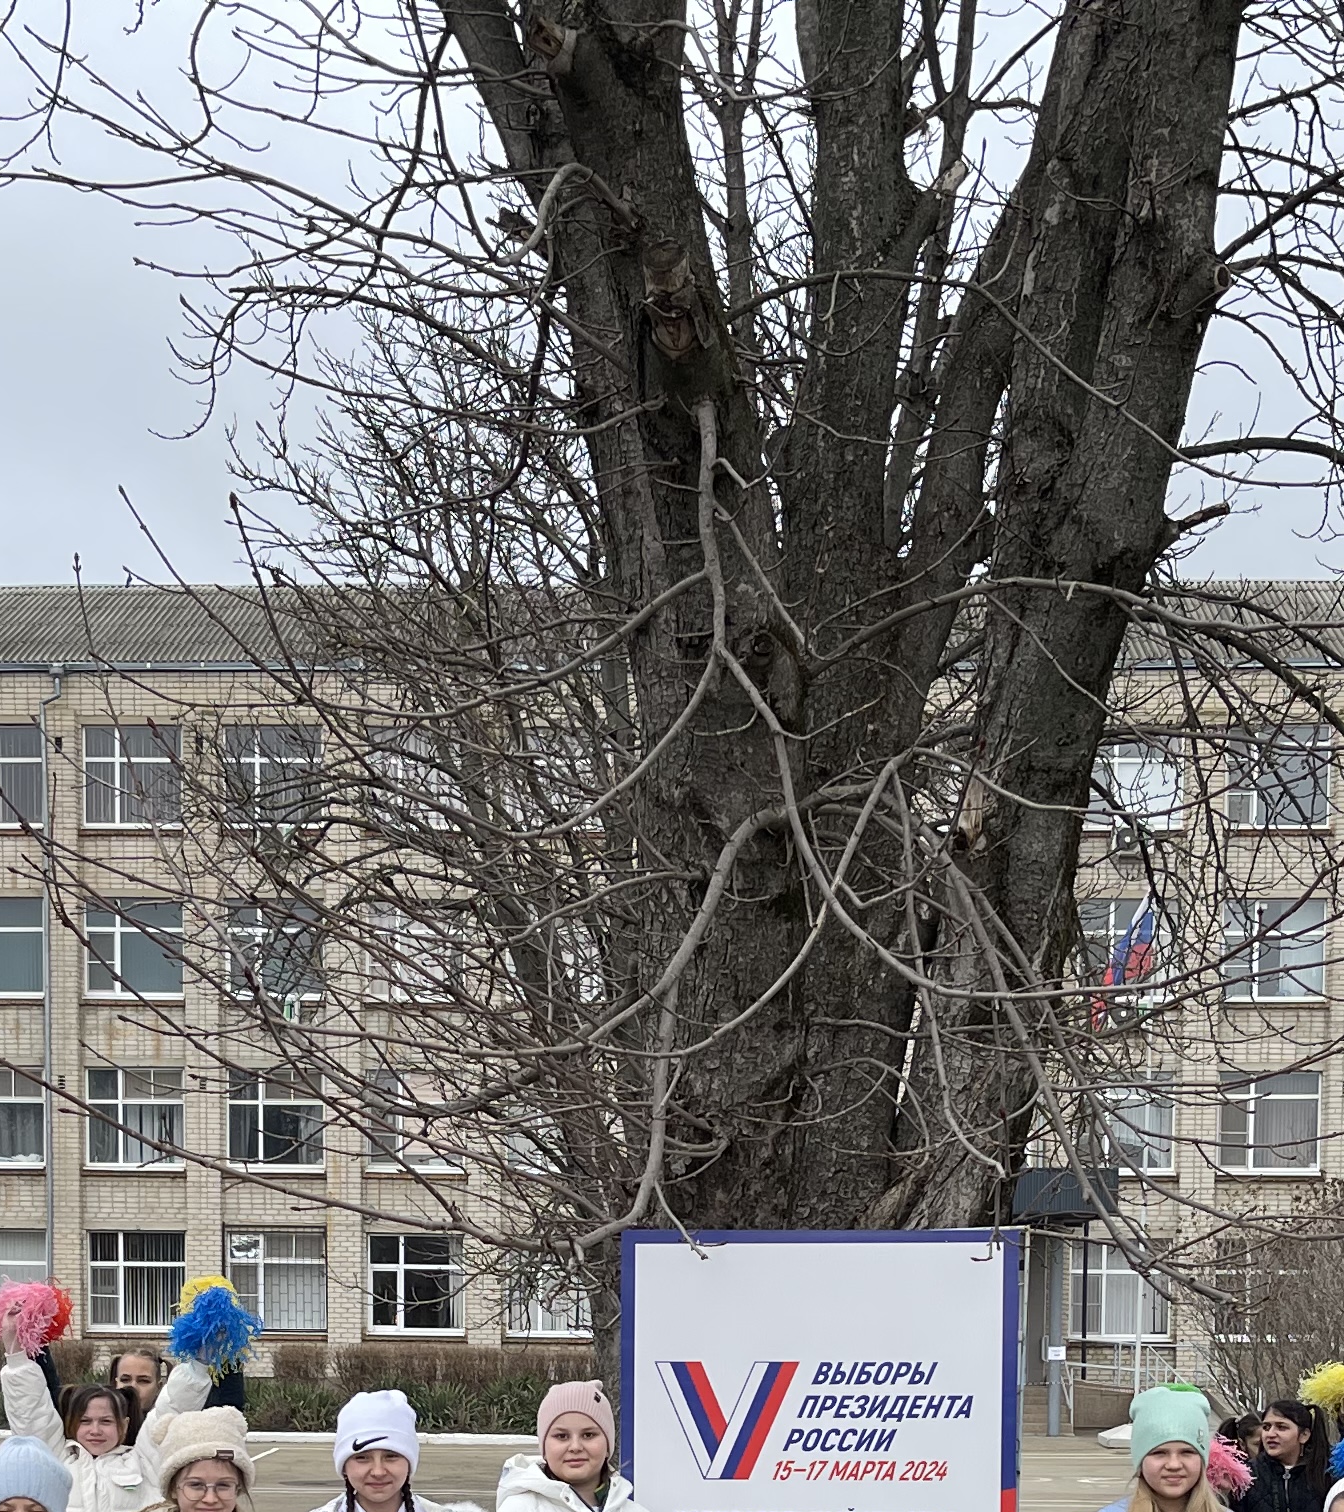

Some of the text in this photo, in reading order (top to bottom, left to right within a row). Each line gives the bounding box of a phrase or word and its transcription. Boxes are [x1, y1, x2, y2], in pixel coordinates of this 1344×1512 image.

[811, 1361, 938, 1386] ВЫБОРЫ
[796, 1394, 974, 1422] ПРЕЗИДЕНТА
[782, 1428, 898, 1452] РОССИИ
[828, 1461, 896, 1482] МАРТА
[898, 1461, 948, 1482] 2024
